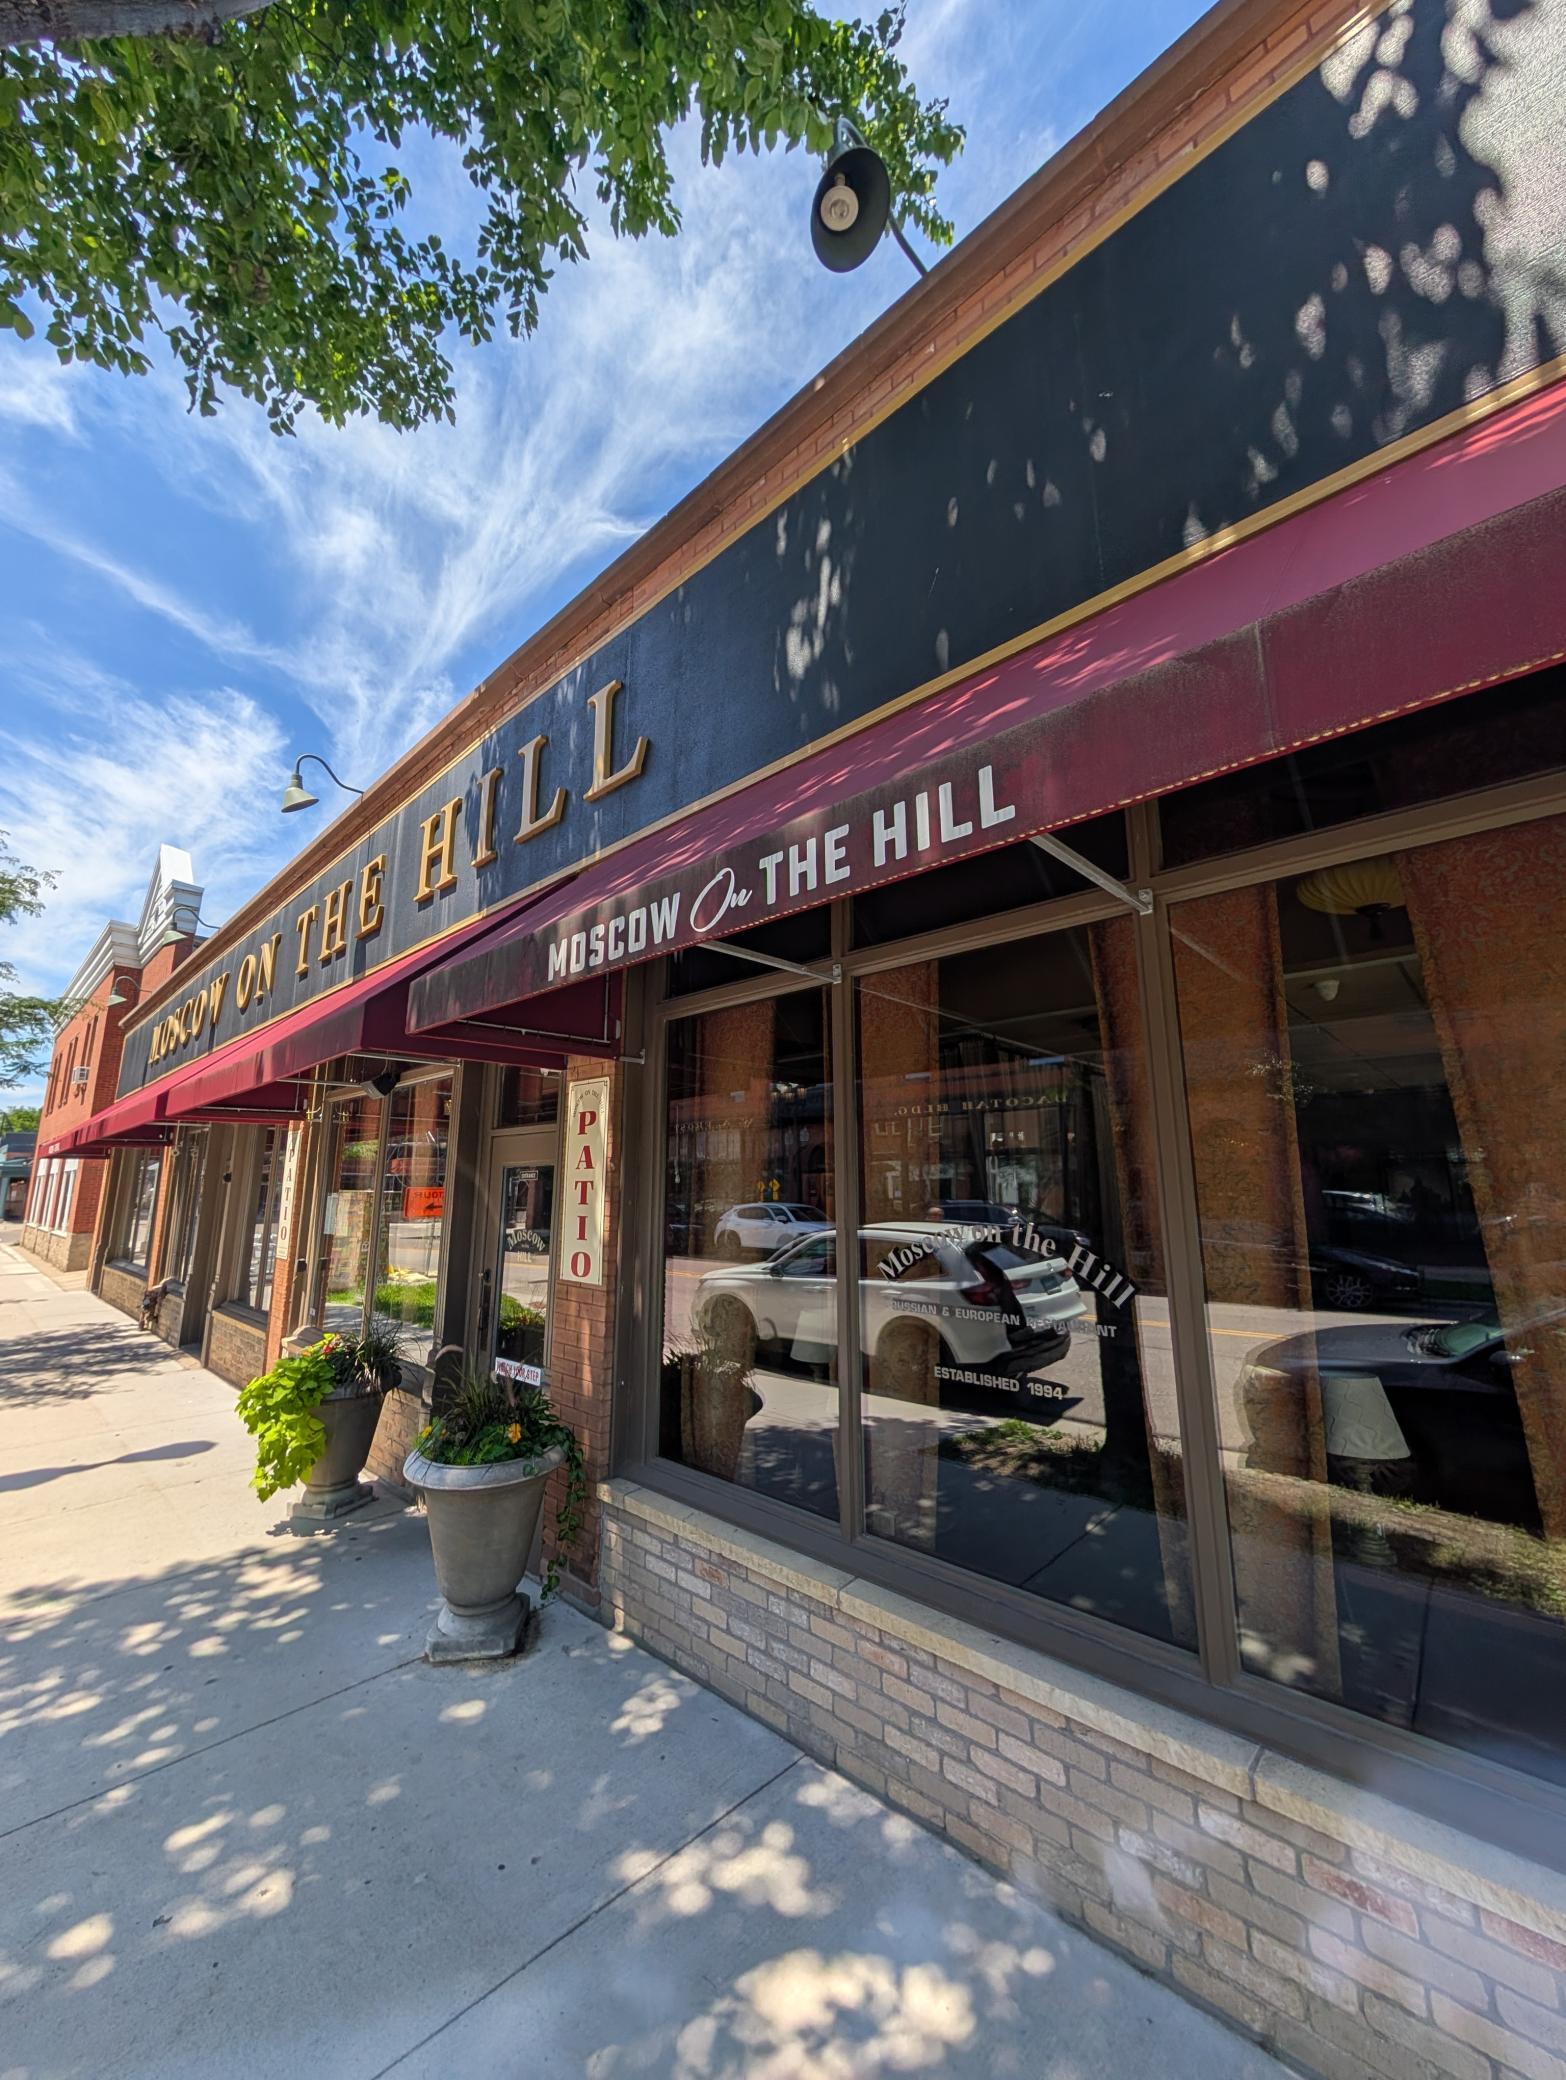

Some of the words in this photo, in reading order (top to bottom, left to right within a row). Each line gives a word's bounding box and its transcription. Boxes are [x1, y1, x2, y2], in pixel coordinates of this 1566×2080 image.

[148, 972, 230, 1065] MOSCOW
[235, 933, 282, 1011] ON
[294, 853, 388, 976] THE
[413, 679, 649, 904] HILL
[547, 892, 681, 982] MOSCOW
[758, 823, 852, 906] THE
[872, 764, 1016, 868] HILL
[280, 1148, 295, 1241] PATIO
[571, 1110, 598, 1278] PATIO
[877, 1225, 967, 1282] Moscow
[971, 1224, 1002, 1244] on
[1011, 1222, 1057, 1257] the
[1065, 1241, 1137, 1310] Hill
[890, 1300, 937, 1315] RUSSIAN
[942, 1307, 950, 1317] &
[955, 1307, 1020, 1326] EUROPEAN
[934, 1366, 1020, 1392] ESTABLISHED
[1026, 1381, 1063, 1400] 1994
